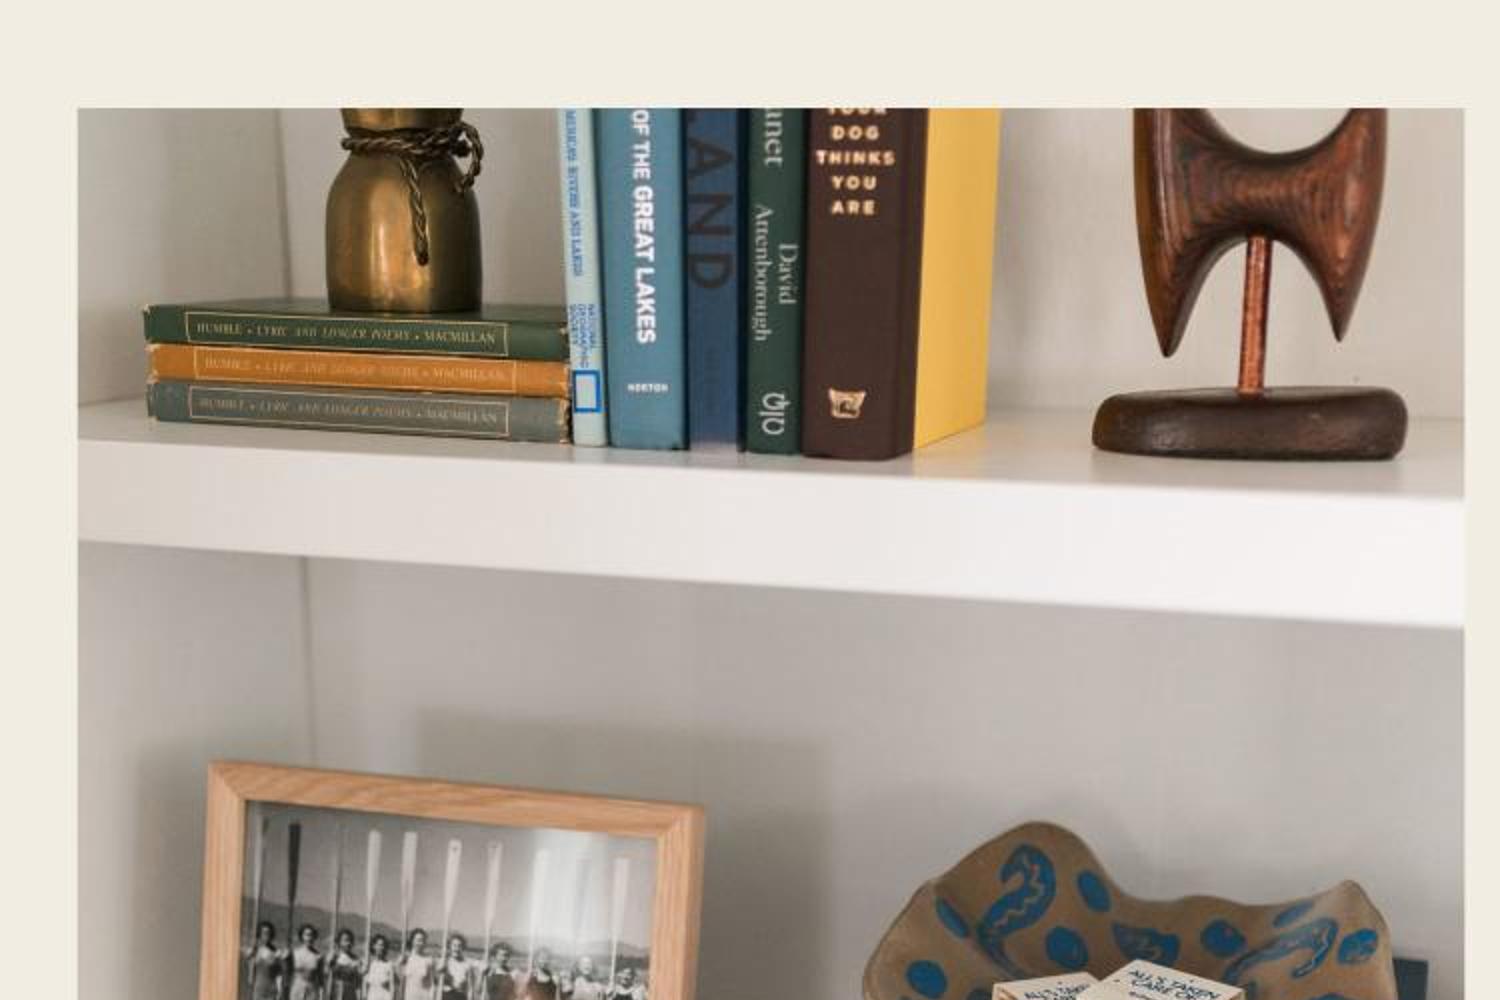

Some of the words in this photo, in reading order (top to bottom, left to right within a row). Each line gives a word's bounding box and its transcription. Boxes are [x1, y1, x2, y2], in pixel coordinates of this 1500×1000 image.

[633, 110, 650, 136] OF
[831, 125, 880, 140] DOG
[633, 140, 651, 179] THE
[815, 149, 896, 165] THINKS
[831, 175, 878, 190] YOU
[687, 109, 734, 291] AND
[831, 200, 876, 215] ARE
[634, 185, 655, 259] GREAT
[752, 204, 774, 341] Attenborough
[779, 243, 798, 304] David
[637, 265, 657, 344] LAKES
[197, 322, 242, 336] HUMBLE
[256, 325, 287, 338] LYRIC
[424, 331, 496, 345] MACMILLAN
[432, 366, 506, 381] MACMILLAN
[427, 407, 498, 423] MACMILLAN
